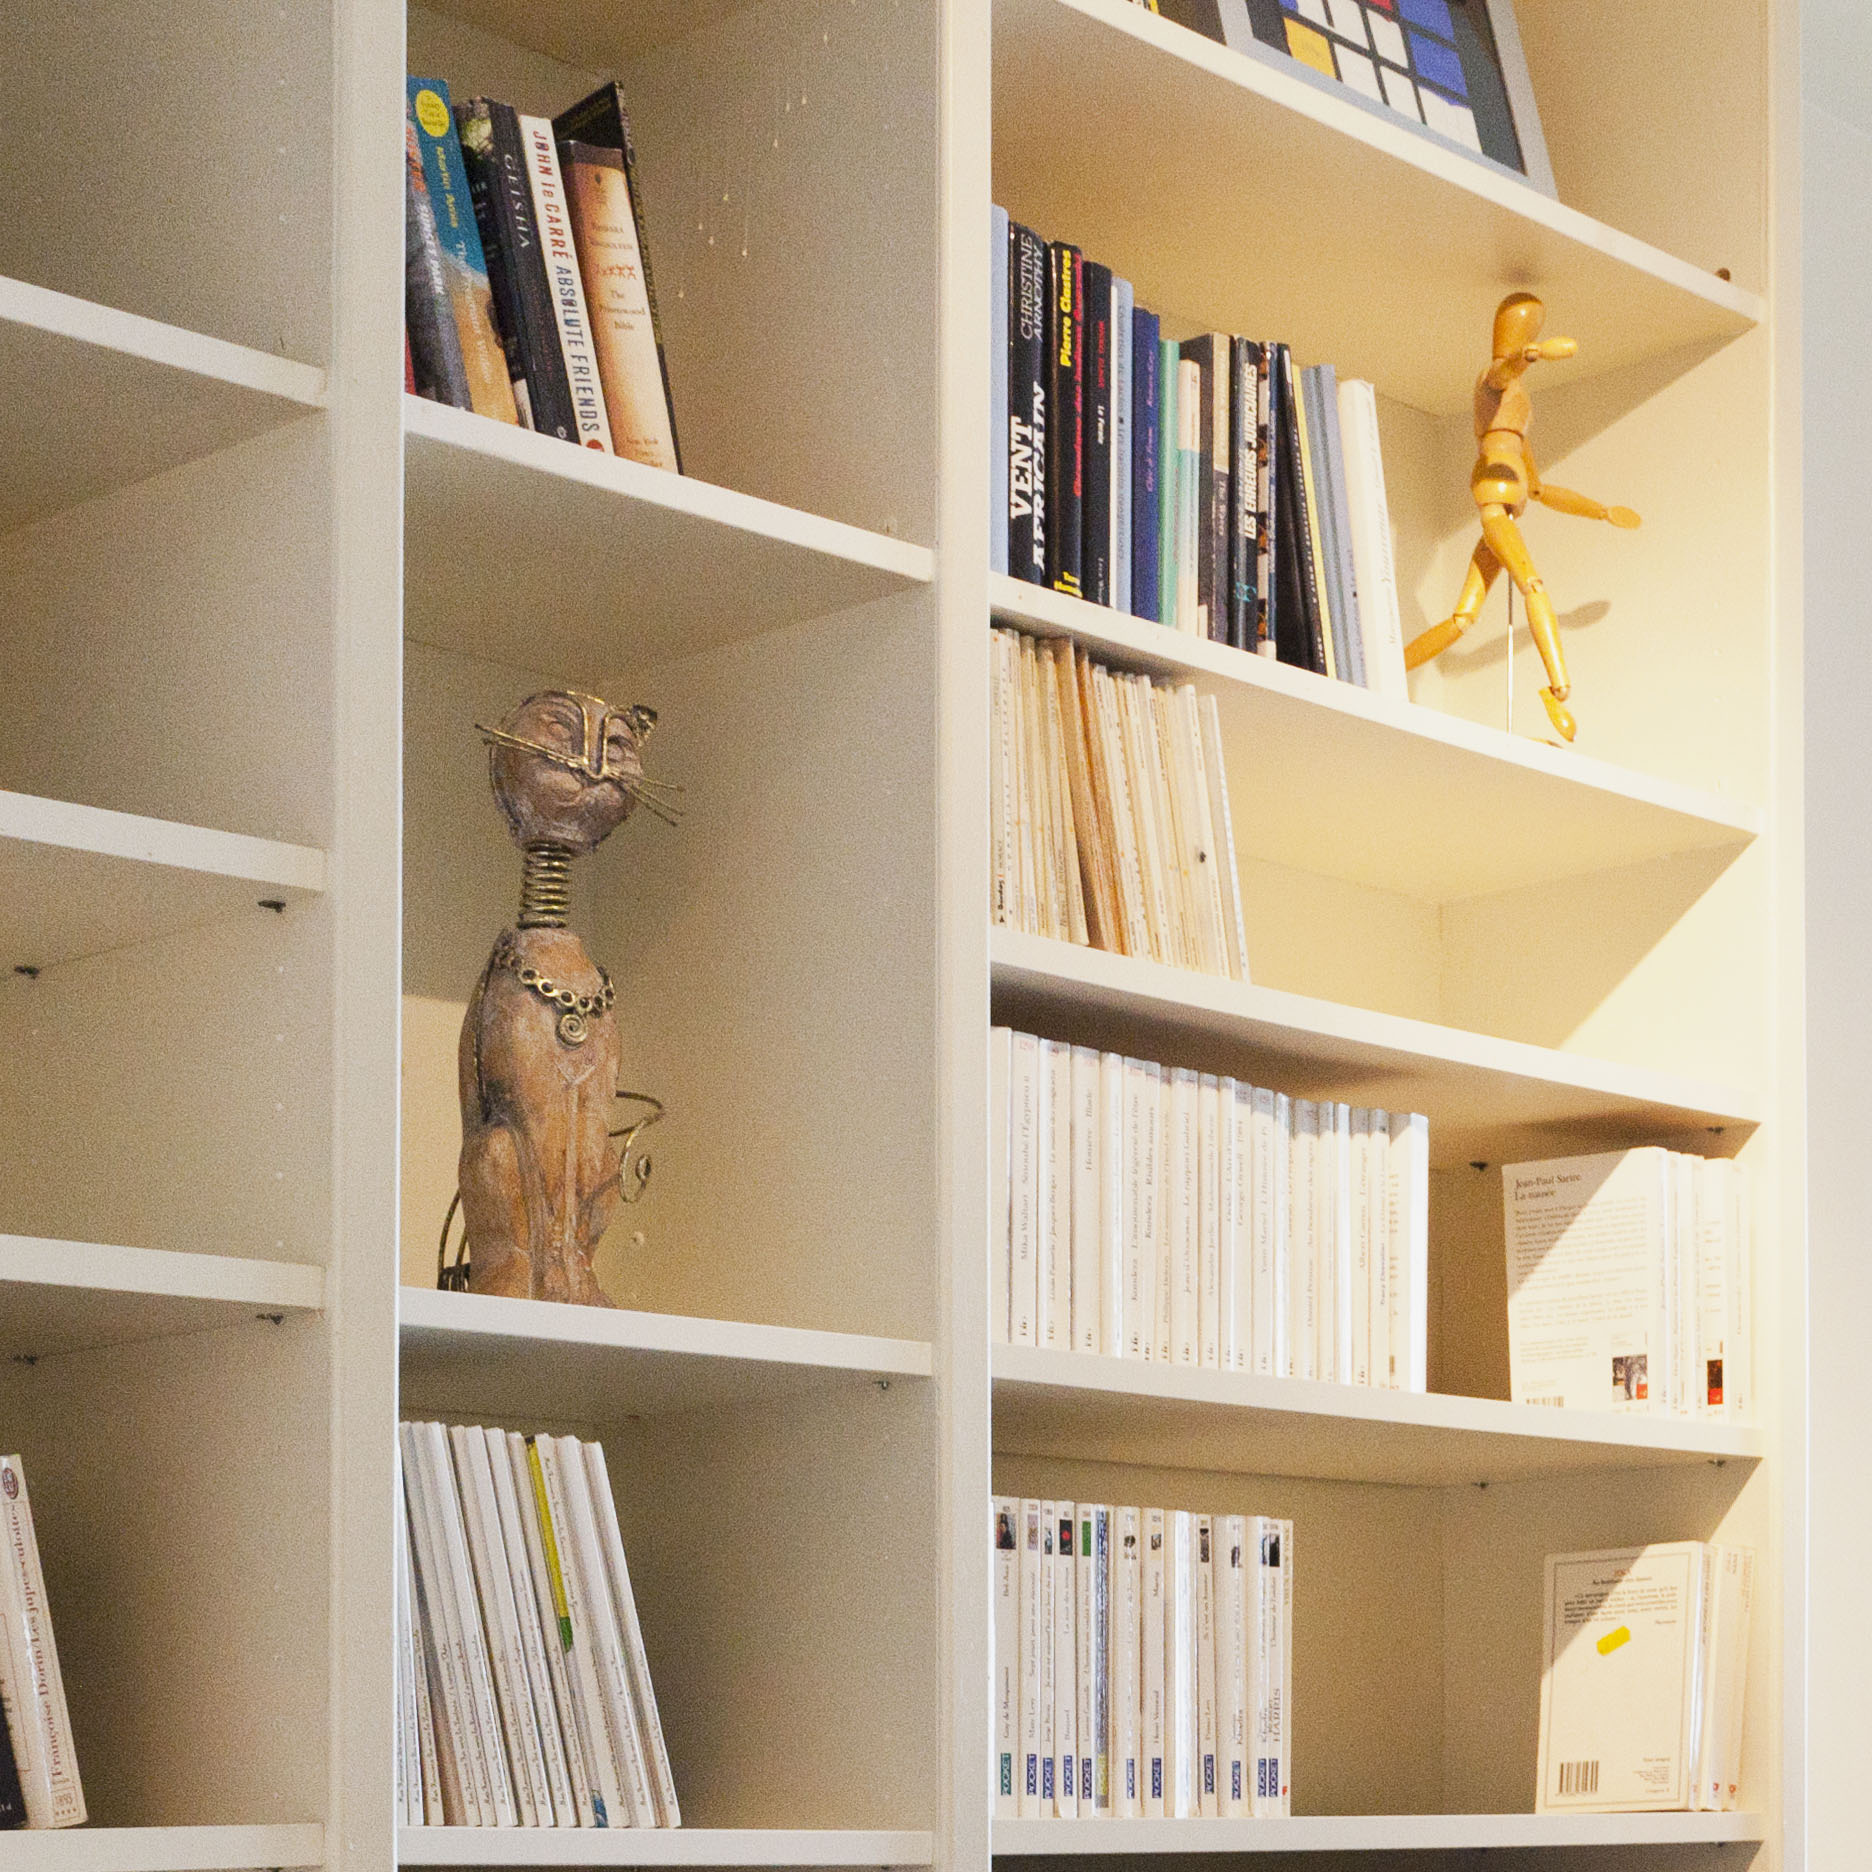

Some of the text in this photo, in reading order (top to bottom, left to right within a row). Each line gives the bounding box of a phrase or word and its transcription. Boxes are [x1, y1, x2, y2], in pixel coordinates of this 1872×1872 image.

[533, 130, 572, 258] JOHN le CARRÉ
[1020, 234, 1034, 340] CHRISTINE
[1033, 244, 1043, 341] ARNOTHY
[1060, 250, 1072, 367] Pierre Clastres
[555, 265, 600, 433] ABSOLUTE FRIENDS
[1010, 415, 1032, 519] VENT
[1033, 381, 1045, 571] AFRICAIN
